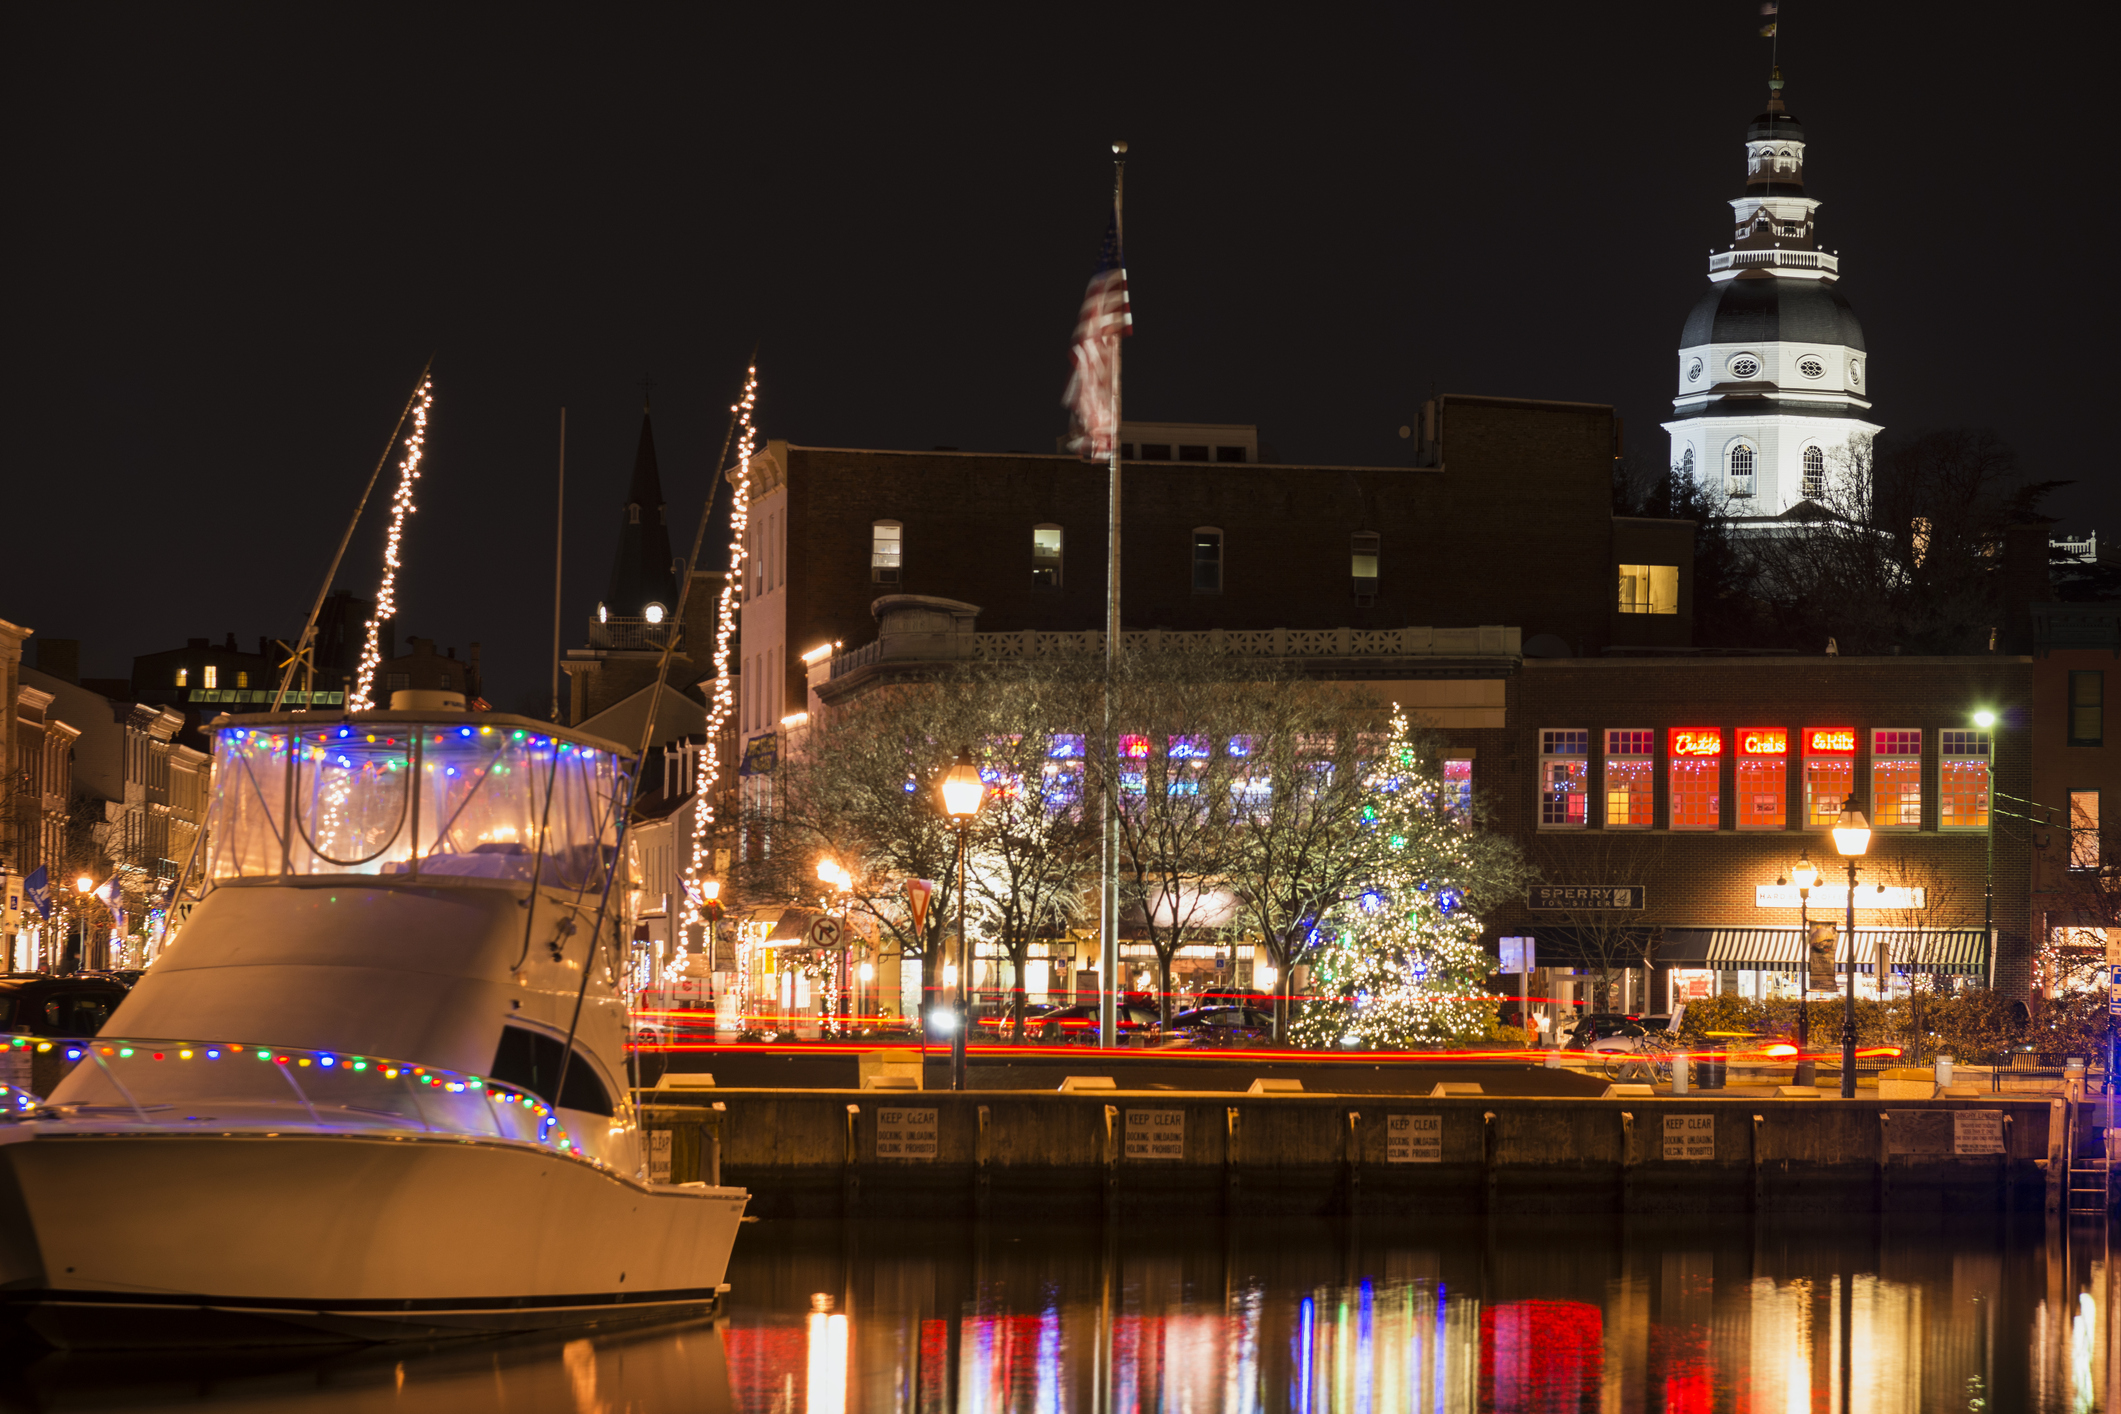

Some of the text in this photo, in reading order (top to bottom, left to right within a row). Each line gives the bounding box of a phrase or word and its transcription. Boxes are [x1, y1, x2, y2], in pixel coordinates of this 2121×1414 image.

[1744, 736, 1787, 754] Crabs
[1540, 888, 1612, 898] SPERRY
[881, 1112, 935, 1124] KEEP CLEAR
[1128, 1114, 1181, 1126] KEEP CLEAR
[1665, 1118, 1712, 1129] KEEP CLEAR
[1390, 1119, 1410, 1130] KEEP
